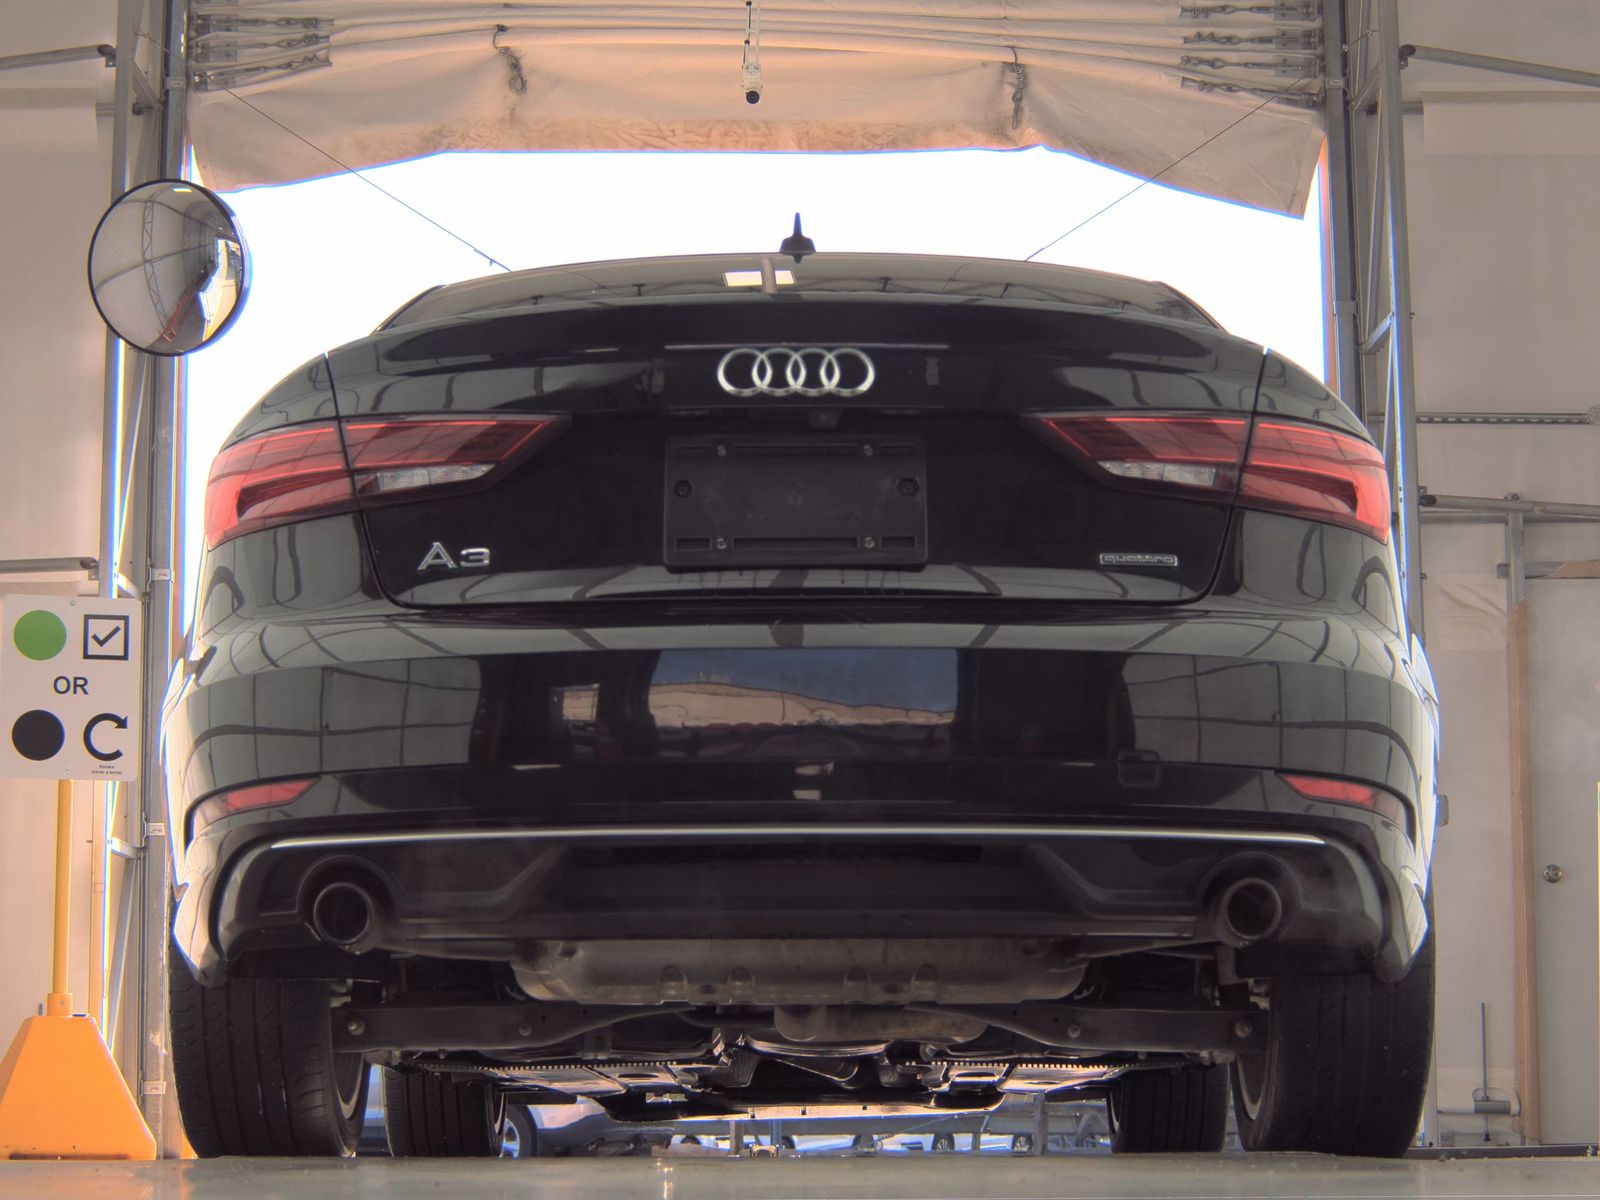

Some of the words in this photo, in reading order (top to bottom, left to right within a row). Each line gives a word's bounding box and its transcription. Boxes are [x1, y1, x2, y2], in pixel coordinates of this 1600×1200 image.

[417, 542, 490, 569] A3
[1103, 554, 1174, 564] quattro
[53, 676, 89, 695] OR
